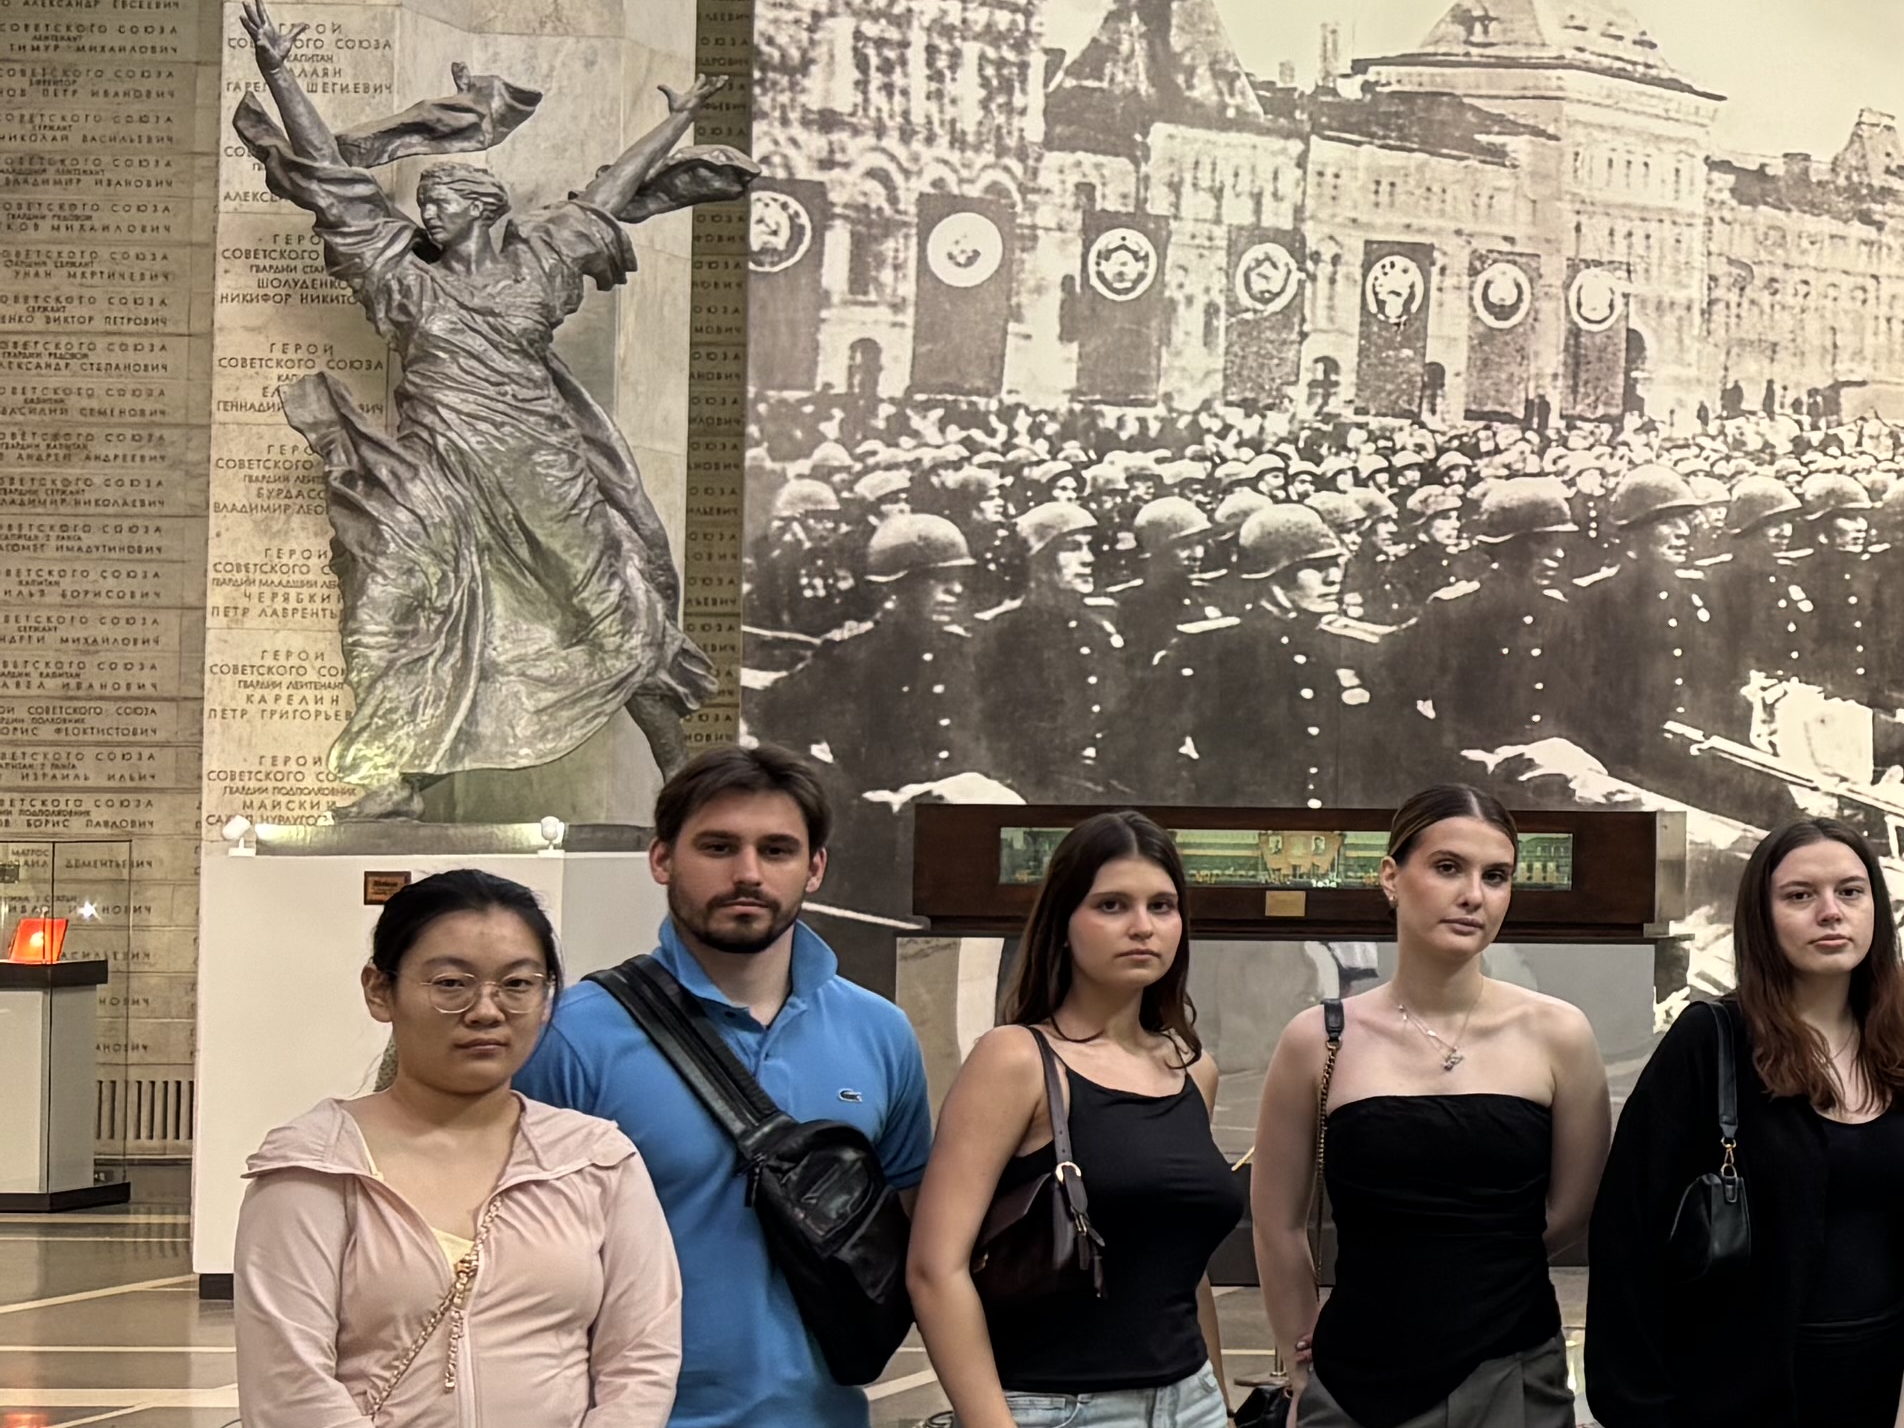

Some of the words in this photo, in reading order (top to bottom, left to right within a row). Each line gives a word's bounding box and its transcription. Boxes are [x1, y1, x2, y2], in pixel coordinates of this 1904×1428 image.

[219, 292, 292, 305] НИКИФОР
[245, 694, 341, 706] КАРЕЛИН
[208, 708, 248, 720] ПЕТР
